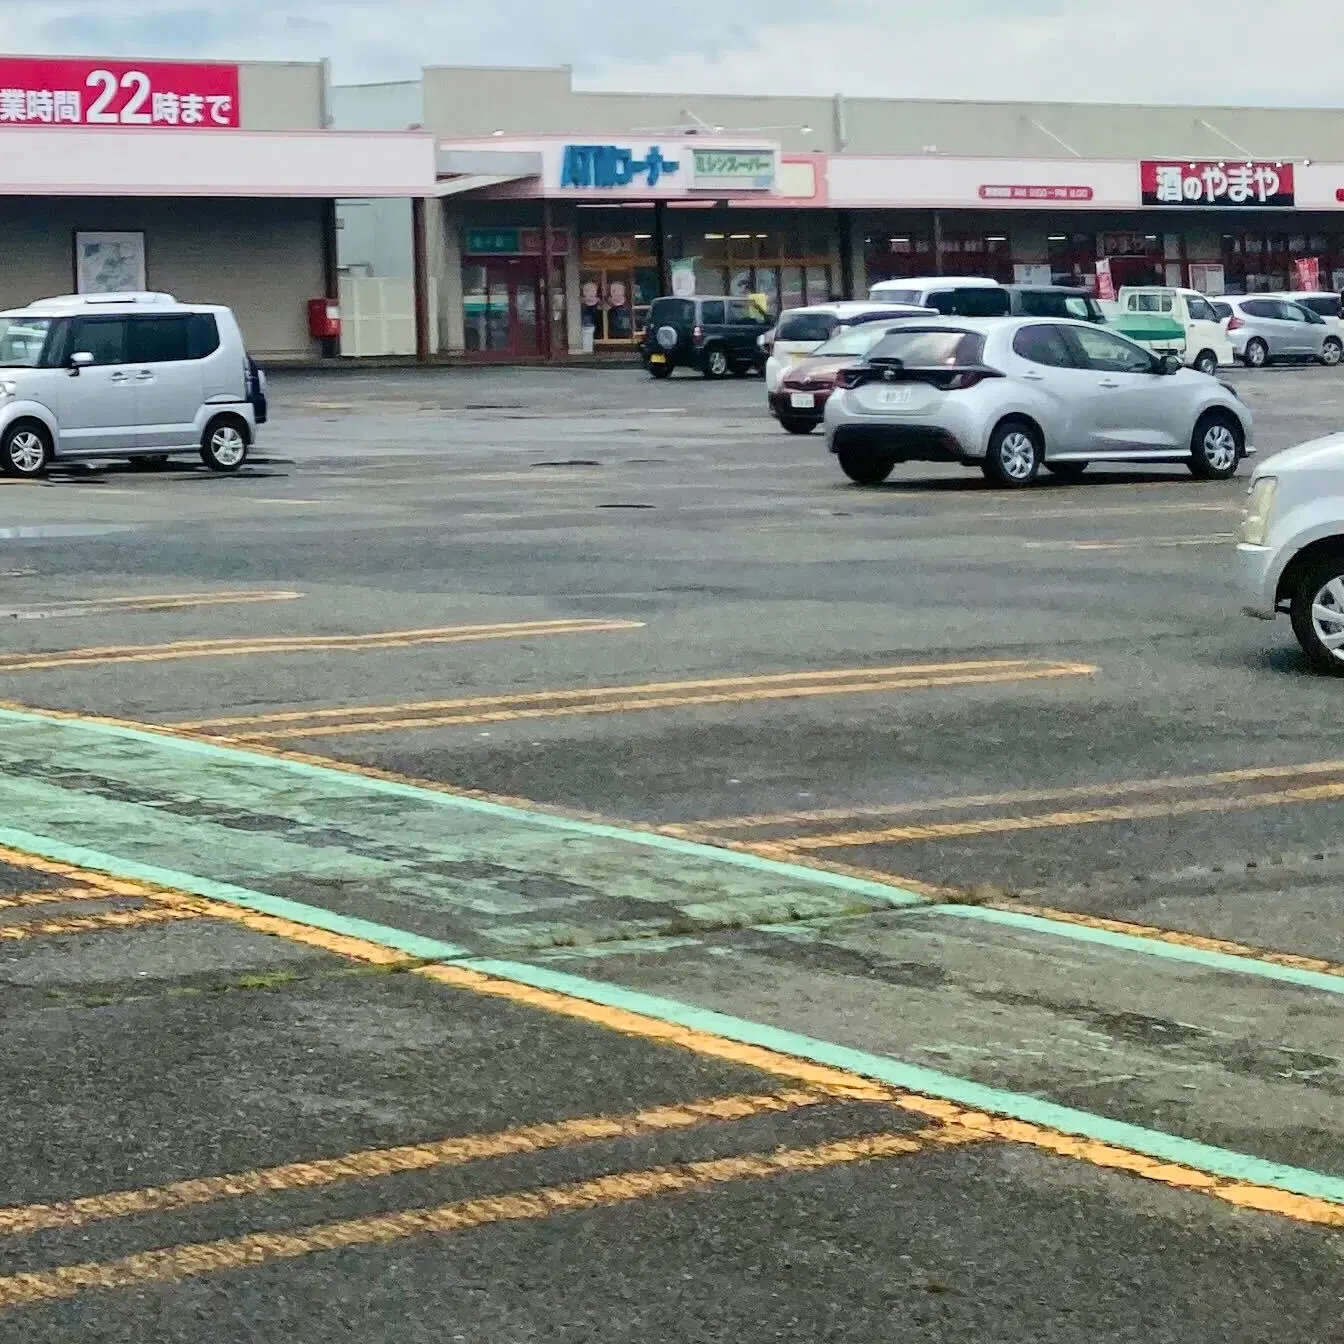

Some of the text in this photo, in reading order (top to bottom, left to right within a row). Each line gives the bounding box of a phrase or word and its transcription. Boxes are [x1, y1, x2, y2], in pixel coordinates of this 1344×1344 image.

[1155, 166, 1280, 202] 酒のやまや
